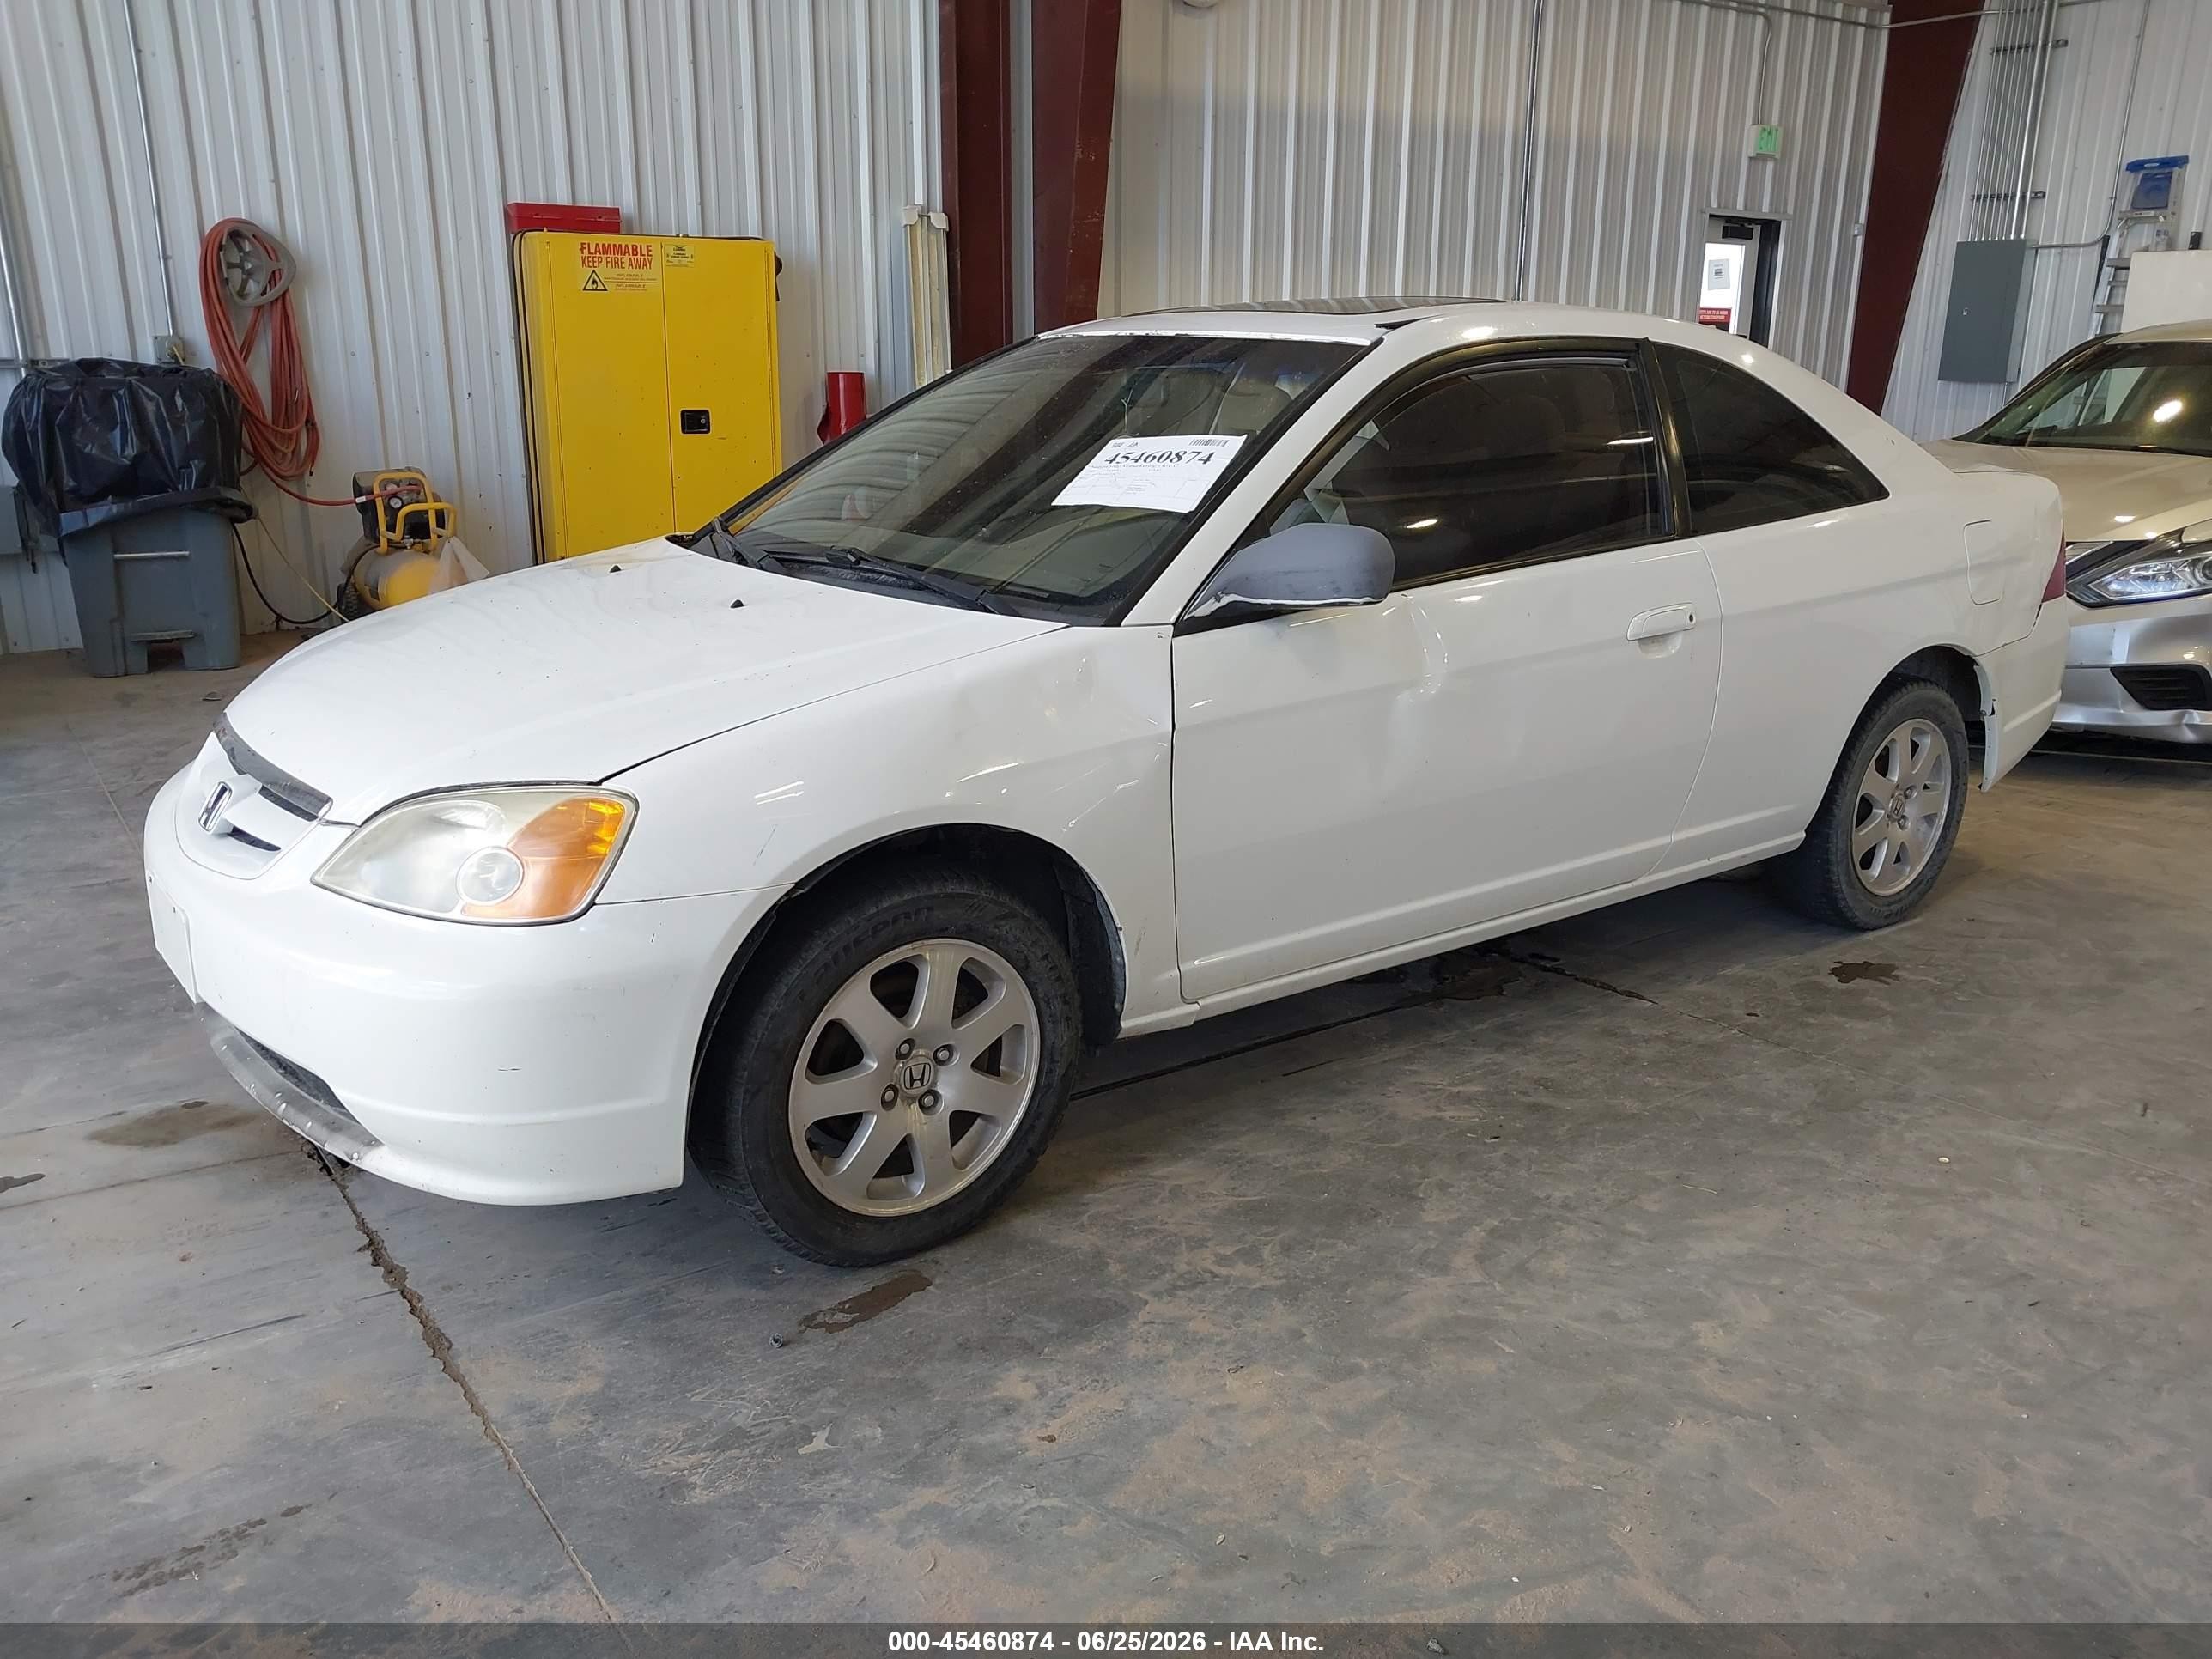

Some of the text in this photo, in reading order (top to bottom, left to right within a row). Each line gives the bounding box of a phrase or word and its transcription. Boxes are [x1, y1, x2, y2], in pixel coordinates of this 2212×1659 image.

[580, 242, 653, 257] FLAMMABLE
[581, 256, 603, 269] KEEP
[605, 257, 626, 270] FIRE
[628, 258, 653, 270] AWAY
[1104, 450, 1215, 465] 45460874
